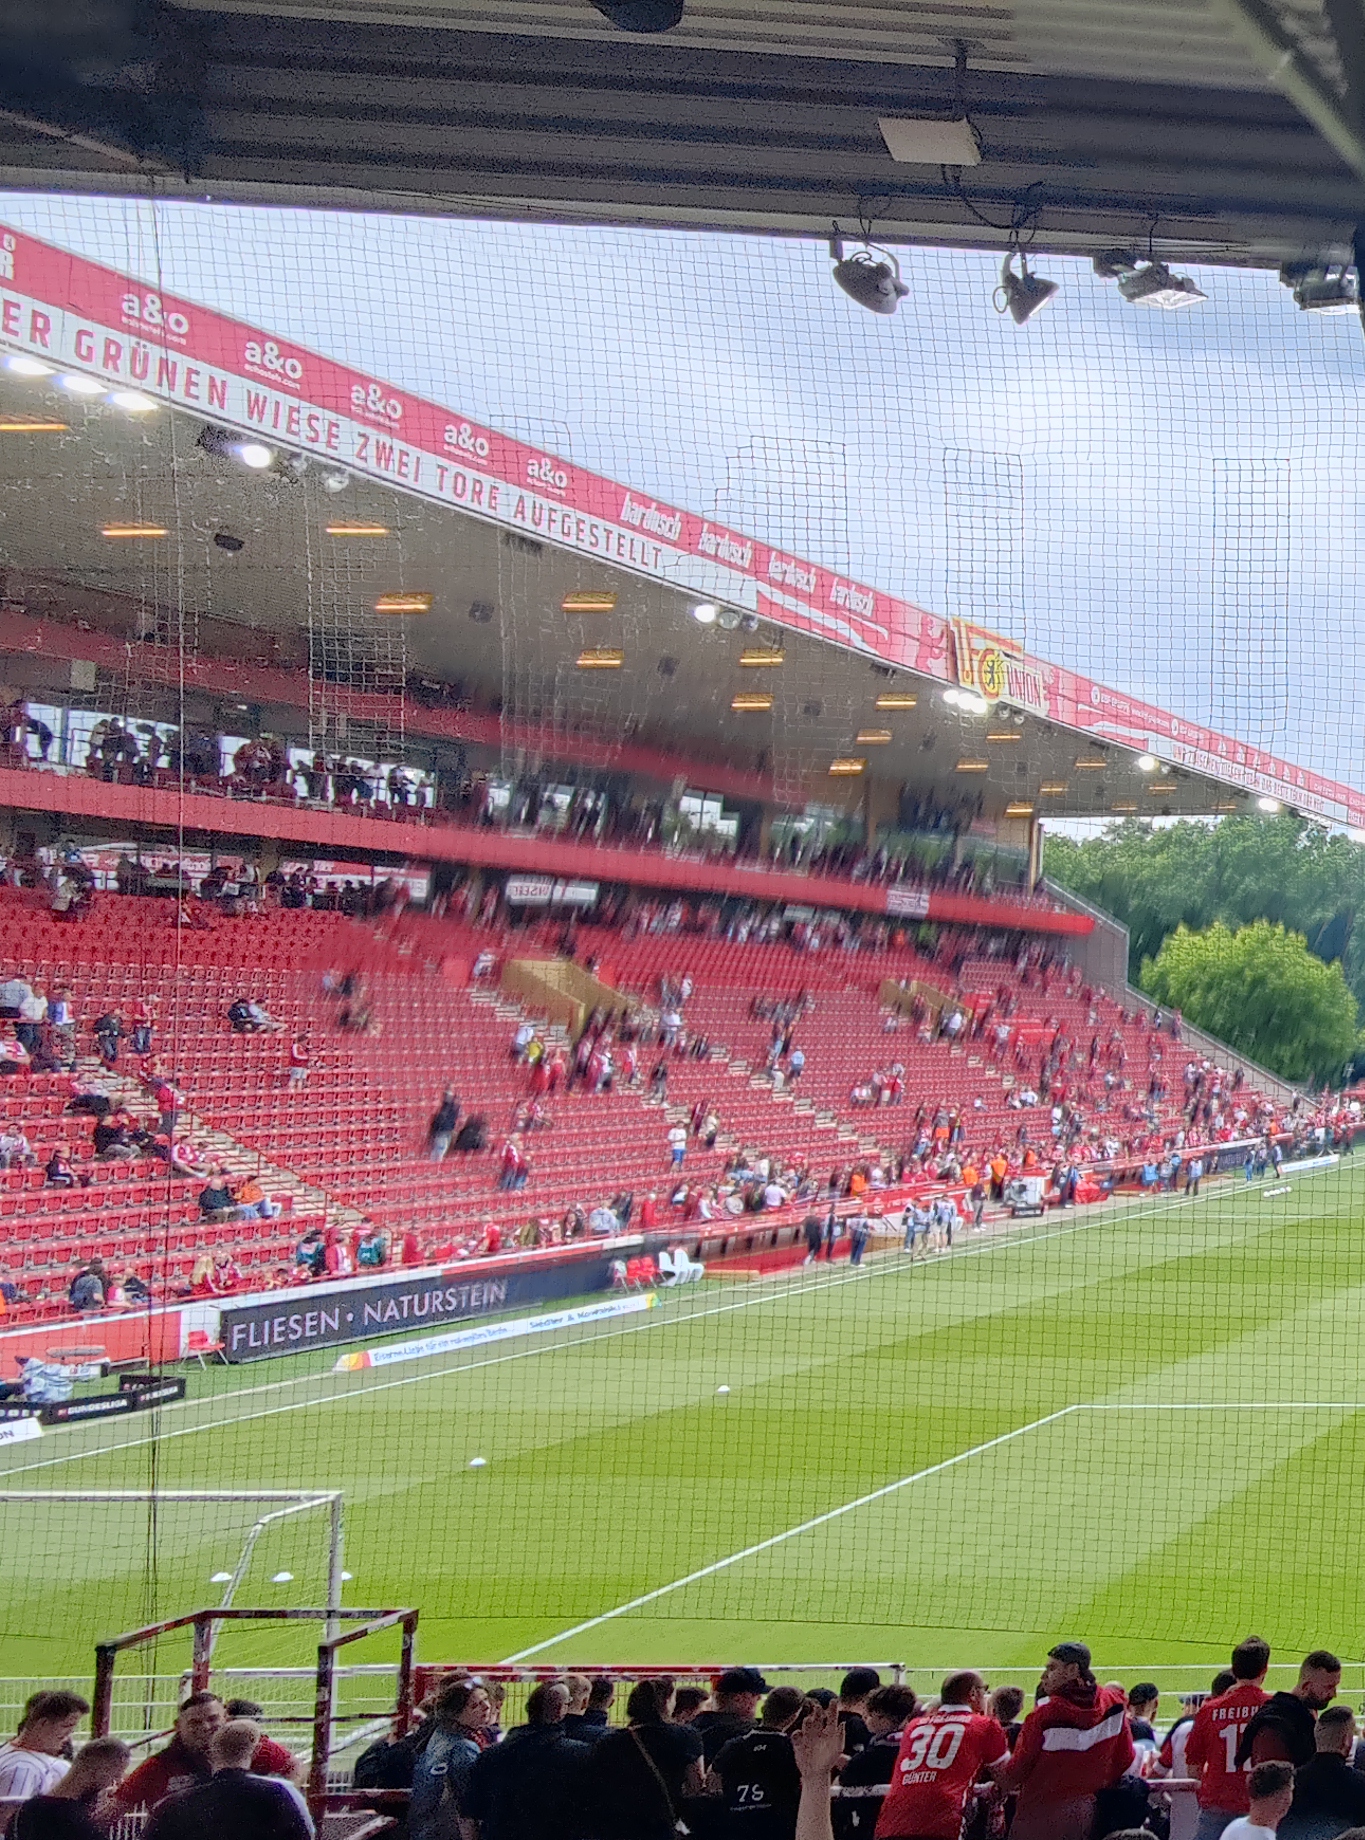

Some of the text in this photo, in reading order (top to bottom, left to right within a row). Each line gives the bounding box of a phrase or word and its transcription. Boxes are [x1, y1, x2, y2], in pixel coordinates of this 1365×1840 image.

[122, 293, 189, 334] a&o
[244, 341, 302, 380] a&o
[351, 384, 402, 419] a&o
[1, 299, 662, 569] ER GRÜNEN WIESE ZWEI TORE AUFGESTELLT
[444, 423, 489, 457] a&o
[527, 458, 567, 488] a&o
[1007, 663, 1043, 708] UNION
[231, 1279, 507, 1351] FLIESEN NATURSTEIN
[1211, 1705, 1260, 1722] FREIBU
[900, 1722, 966, 1773] 30
[902, 1770, 938, 1787] GÜNTER
